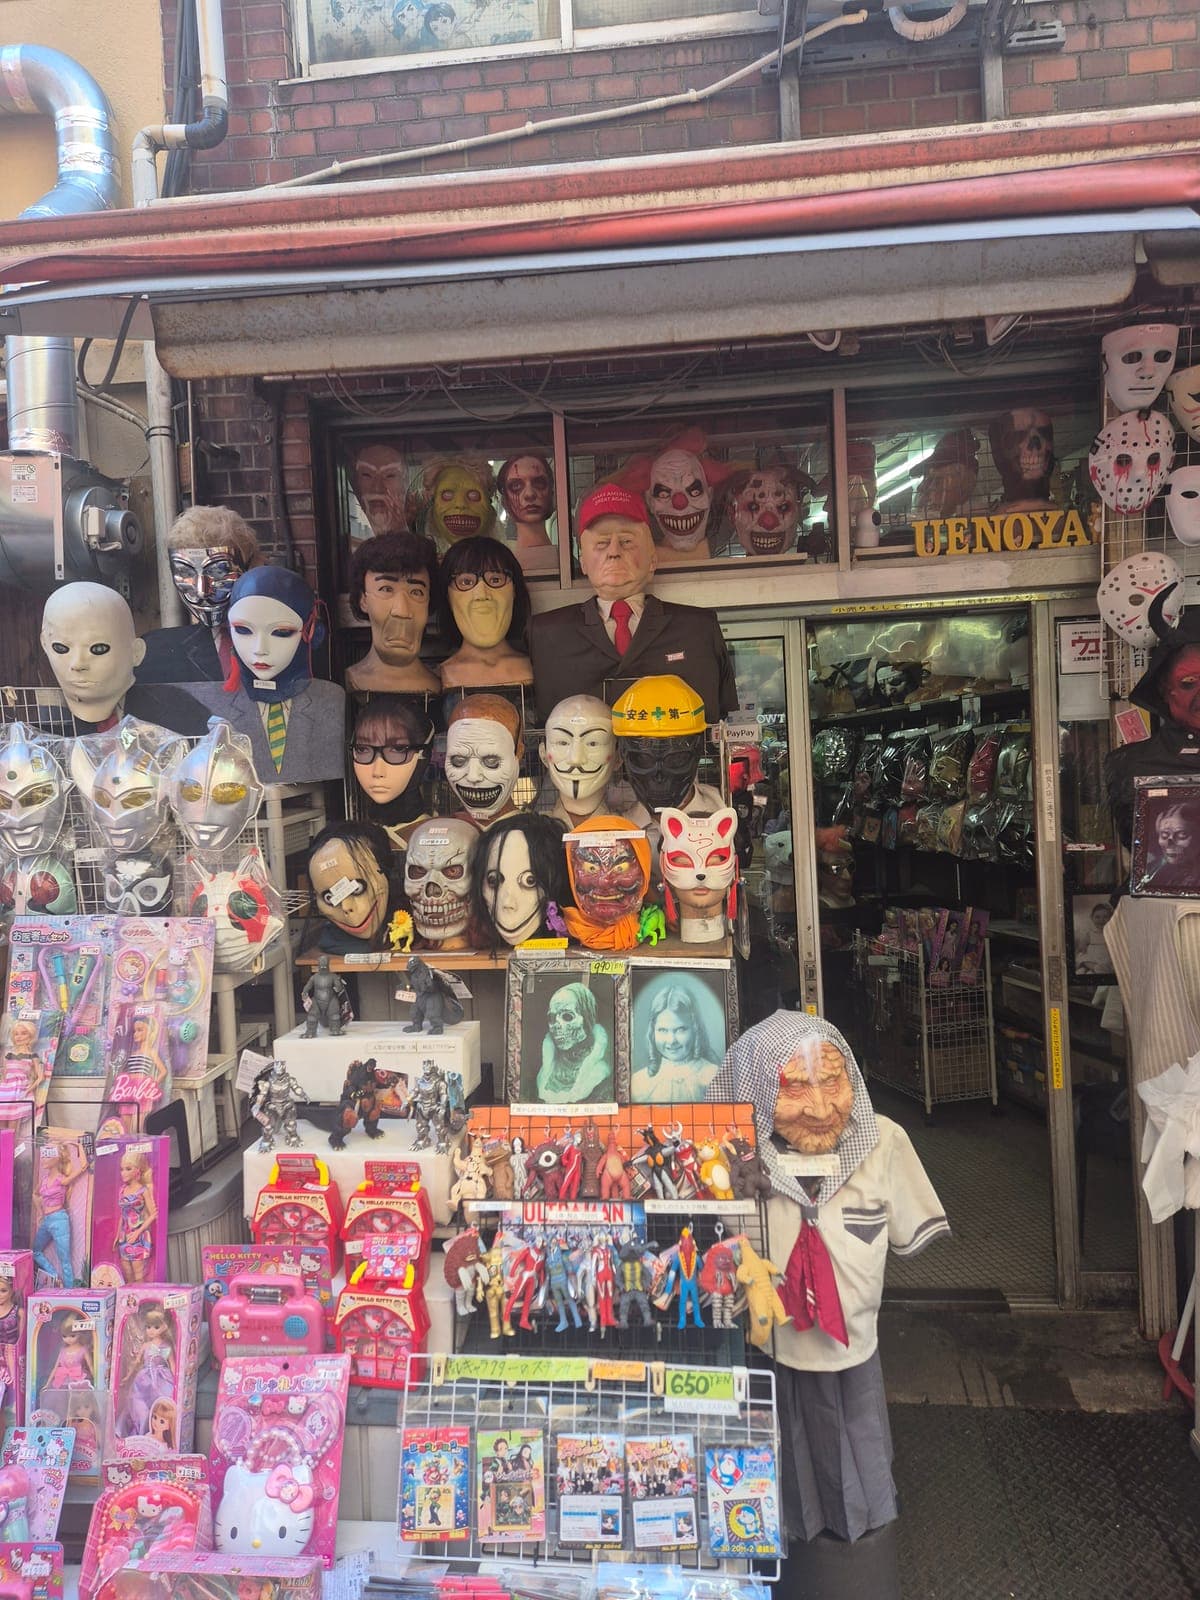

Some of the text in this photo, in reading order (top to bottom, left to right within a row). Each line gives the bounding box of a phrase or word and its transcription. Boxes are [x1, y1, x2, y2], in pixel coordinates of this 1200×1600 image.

[911, 508, 1091, 558] UENOYA
[626, 707, 691, 721] 安全 第一
[726, 729, 755, 738] PayPay
[594, 962, 610, 975] 990
[112, 1074, 162, 1101] Barbie
[215, 1261, 261, 1276] ピアノ
[670, 1374, 710, 1395] 650
